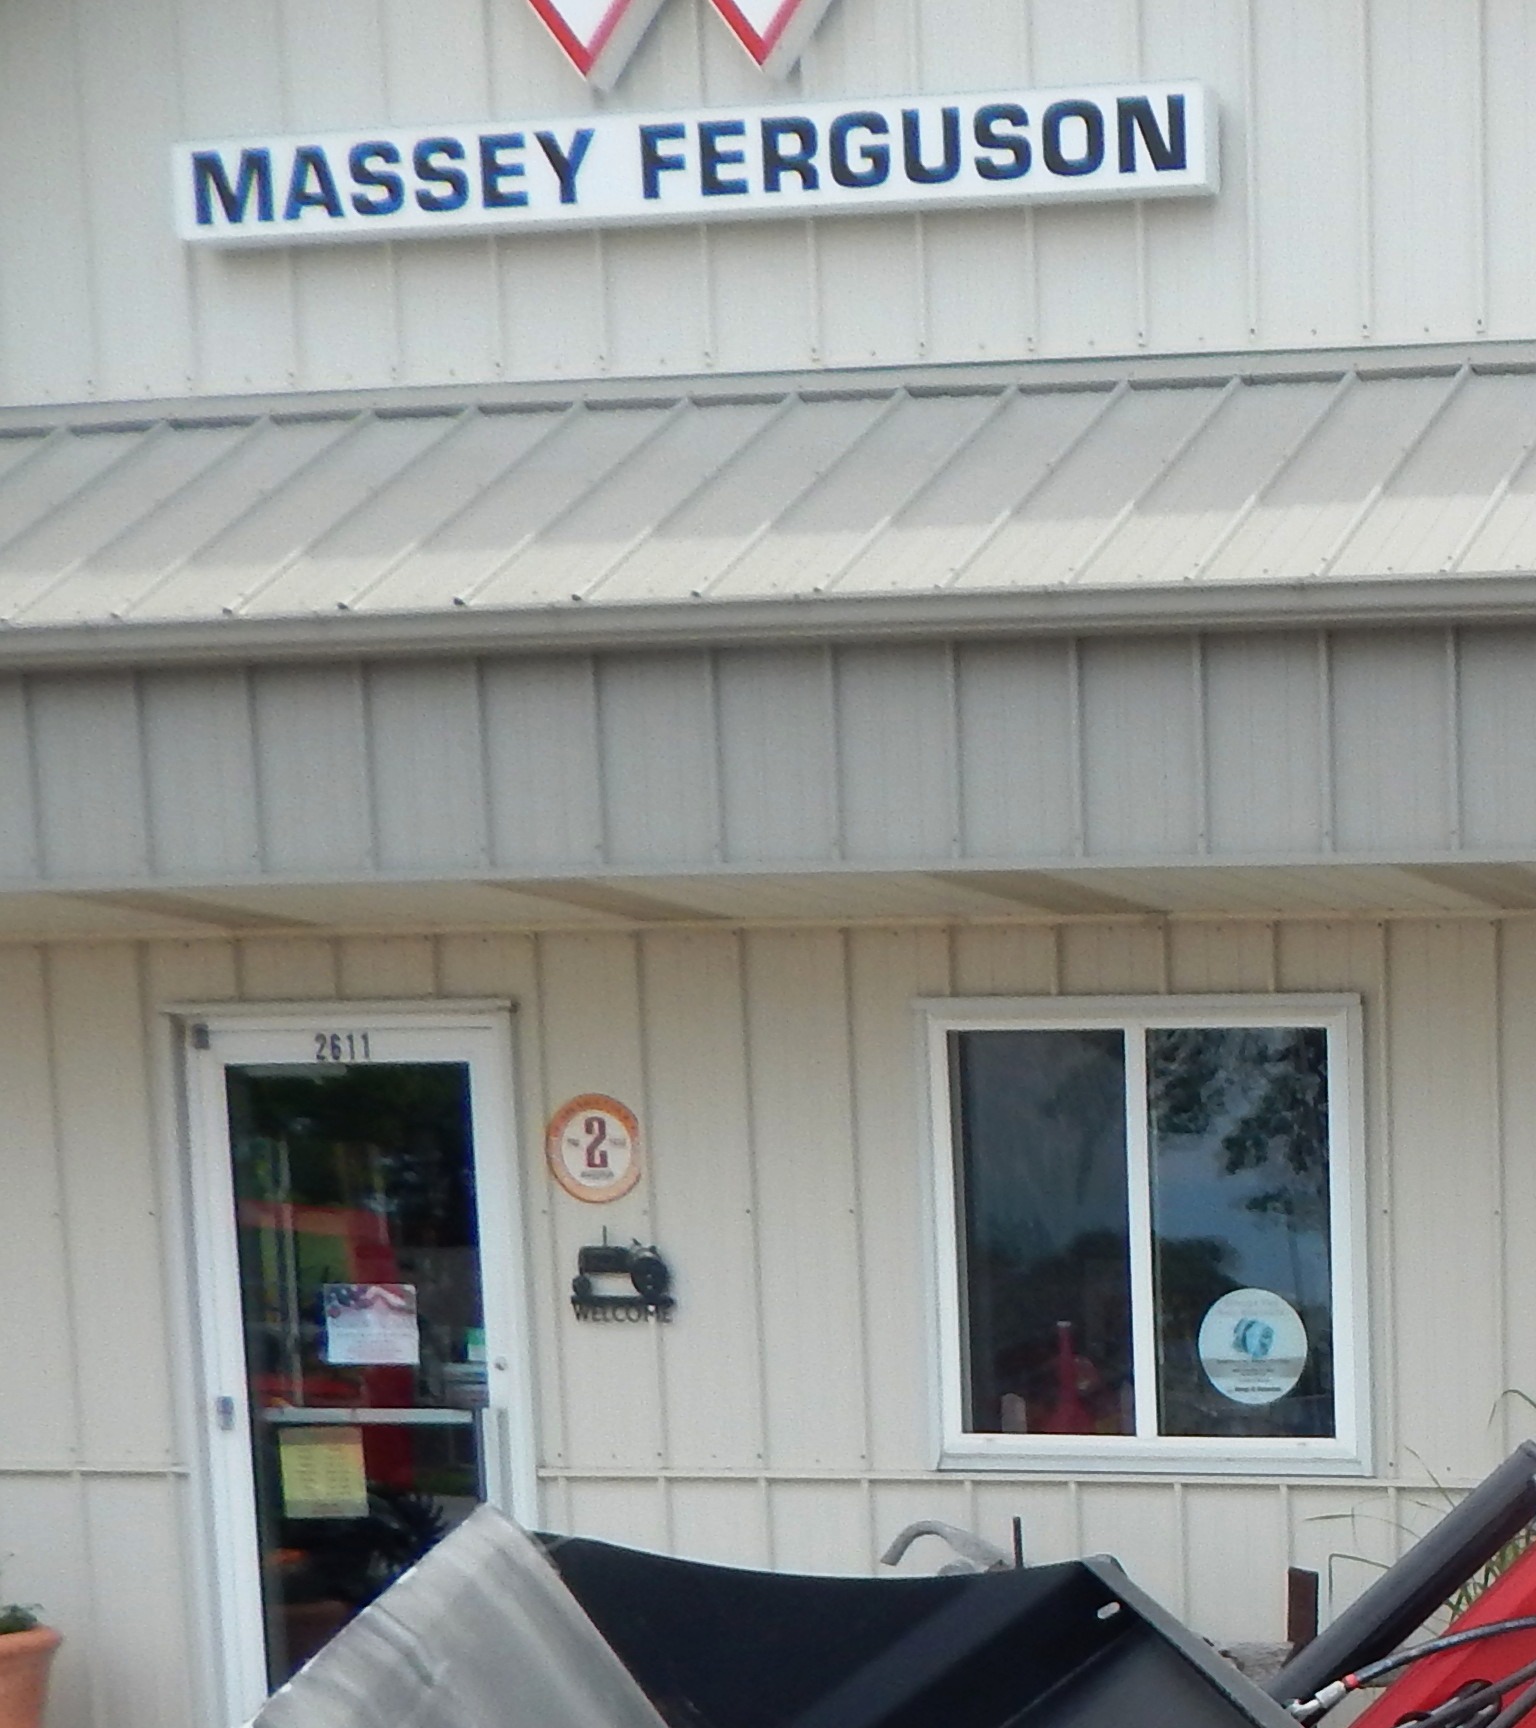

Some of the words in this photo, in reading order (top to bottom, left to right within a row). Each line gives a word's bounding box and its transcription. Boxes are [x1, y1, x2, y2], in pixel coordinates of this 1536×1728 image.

[191, 130, 595, 226] MASSEY
[639, 93, 1187, 199] FERGUSON
[314, 1032, 371, 1062] 2611
[584, 1116, 609, 1169] 2
[573, 1302, 672, 1324] WELCOME
